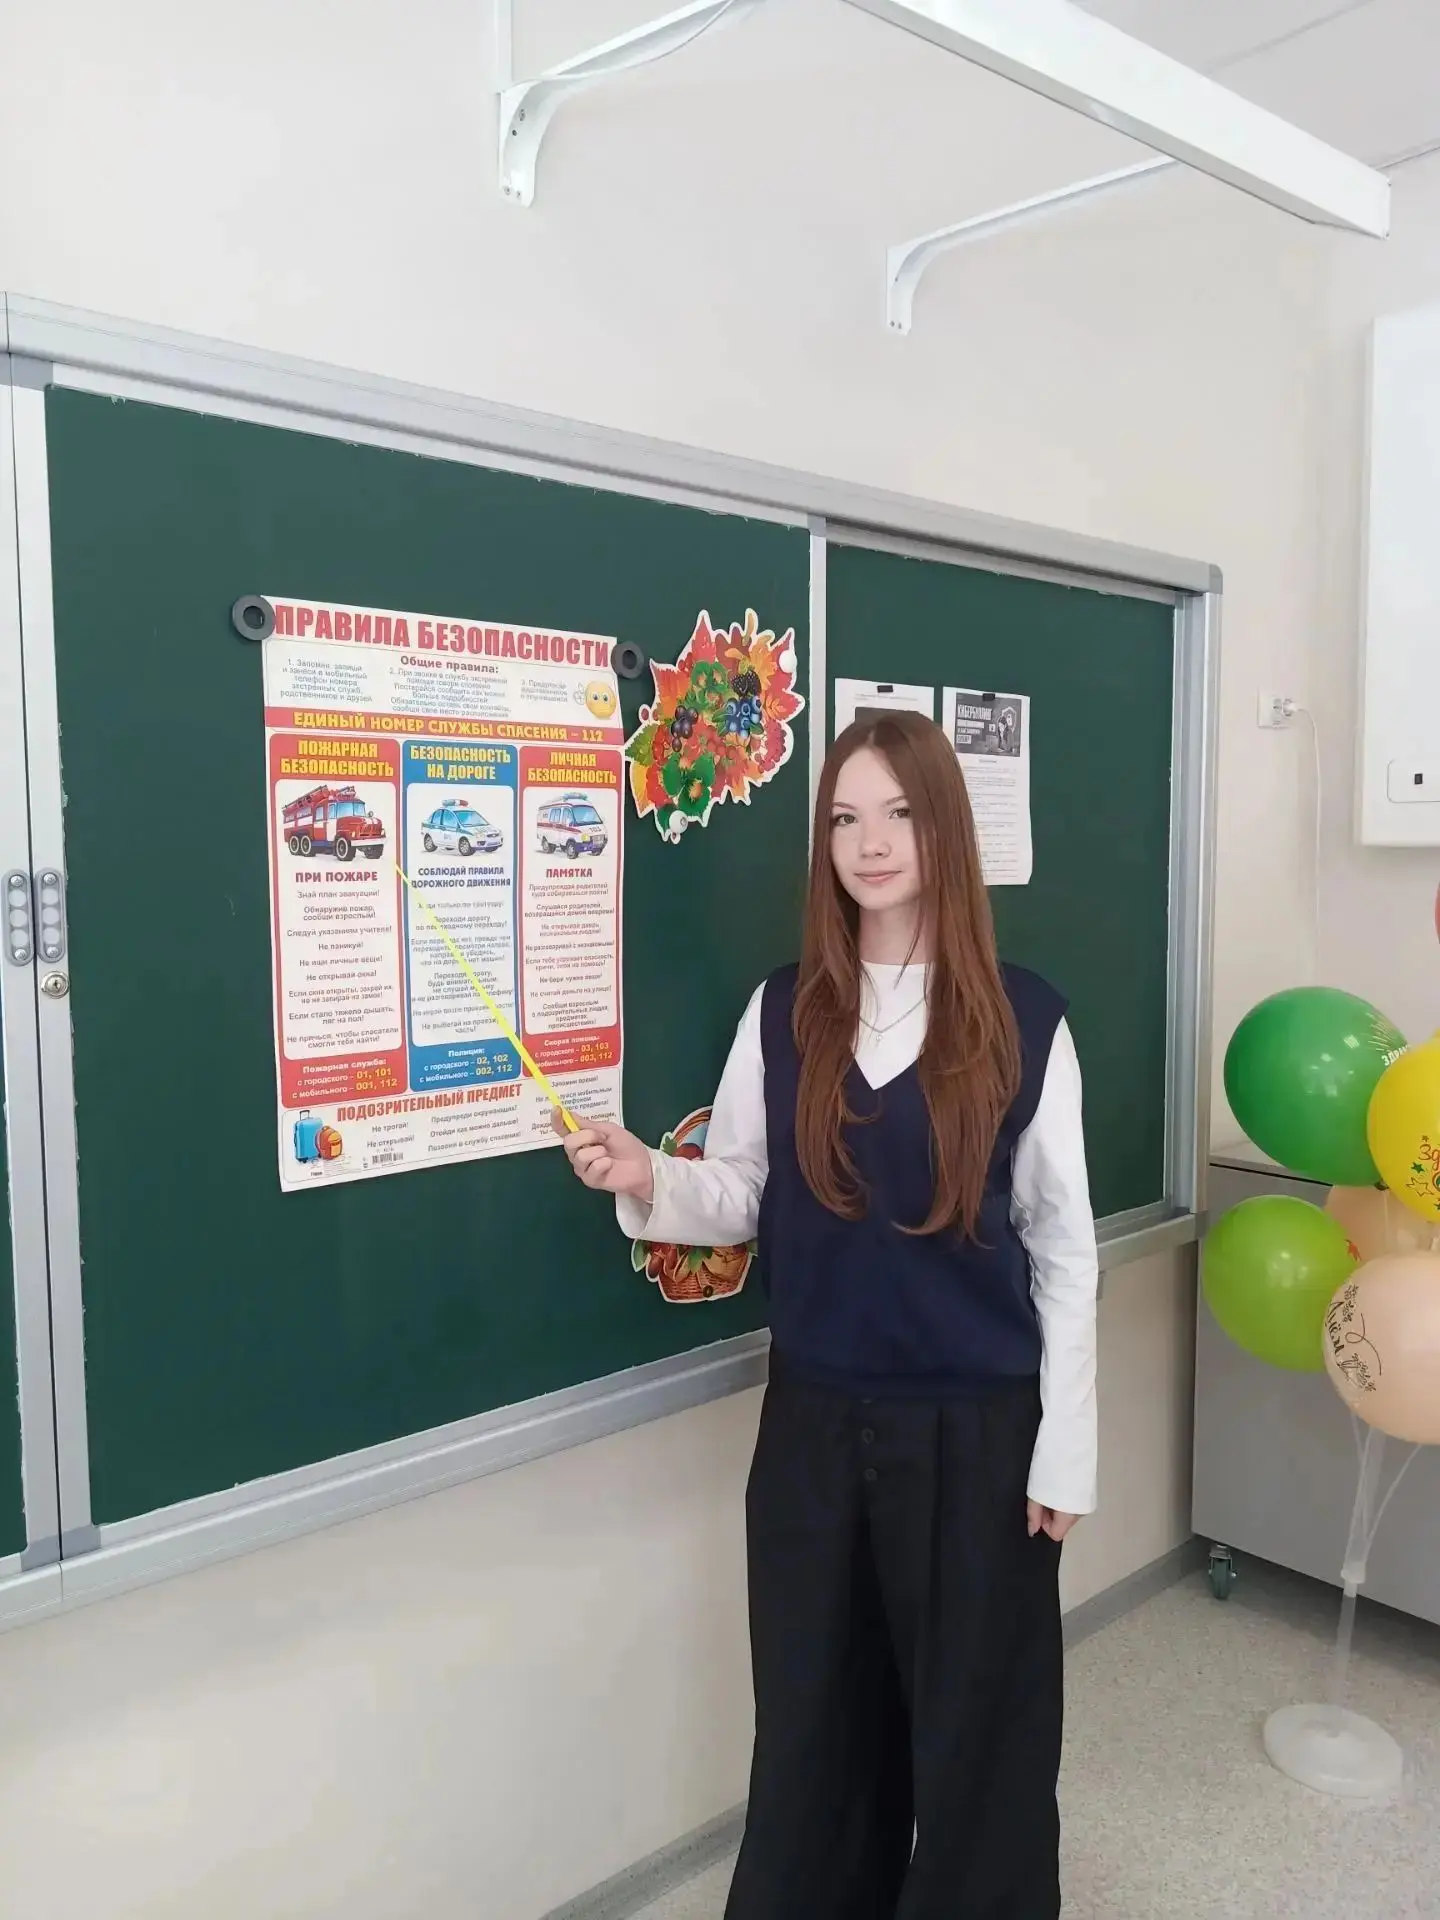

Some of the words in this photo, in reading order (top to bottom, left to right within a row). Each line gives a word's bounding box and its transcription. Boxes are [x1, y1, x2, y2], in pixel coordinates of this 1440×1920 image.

[274, 604, 410, 647] ПРАВИЛА
[417, 620, 609, 667] БЕЗОПАСНОСТИ
[401, 656, 442, 668] Общие
[446, 661, 499, 673] правила:
[294, 711, 366, 729] ЕДИНЫЙ
[371, 715, 424, 732] НОМЕР
[428, 720, 494, 737] СЛУЖБЫ
[497, 724, 568, 740] СПАСЕНИЯ
[582, 729, 604, 742] 112
[298, 740, 378, 758] ПОЖАРНАЯ
[410, 745, 511, 763] БЕЗОПАСНОСТЬ
[549, 752, 596, 766] ЛИЧНАЯ
[280, 758, 394, 776] БЕЗОПАСНОСТЬ
[427, 764, 444, 778] НА
[447, 764, 496, 780] ДОРОГЕ
[528, 768, 616, 783] БЕЗОПАСНОСТЬ
[296, 872, 321, 882] ПРИ
[326, 872, 378, 882] ПОЖАРЕ
[418, 866, 466, 876] СОБЛЮДАЙ
[468, 867, 504, 875] ПРАВИЛА
[546, 868, 593, 878] ПАМЯТКА
[466, 878, 511, 887] ДВИЖЕНИЯ
[298, 891, 316, 899] Знай
[287, 929, 316, 937] Следуй
[544, 1038, 570, 1046] Скорая
[595, 1042, 609, 1050] 103
[448, 1048, 485, 1057] Полиция:
[303, 1064, 349, 1073] Пожарная
[351, 1059, 387, 1068] служба:
[430, 1061, 469, 1071] городского
[477, 1057, 490, 1065] 02,
[493, 1054, 508, 1062] 102
[304, 1075, 348, 1085] городского
[356, 1071, 372, 1079] 01,
[375, 1068, 391, 1077] 101
[426, 1071, 468, 1082] мобильного
[476, 1067, 494, 1076] 002,
[497, 1064, 513, 1072] 112
[299, 1086, 348, 1098] мобильного
[356, 1081, 377, 1090] 001,
[380, 1078, 397, 1087] 112
[337, 1089, 464, 1122] ПОДОЗРИТЕЛЬНЫЙ
[467, 1084, 522, 1103] ПРЕДМЕТ
